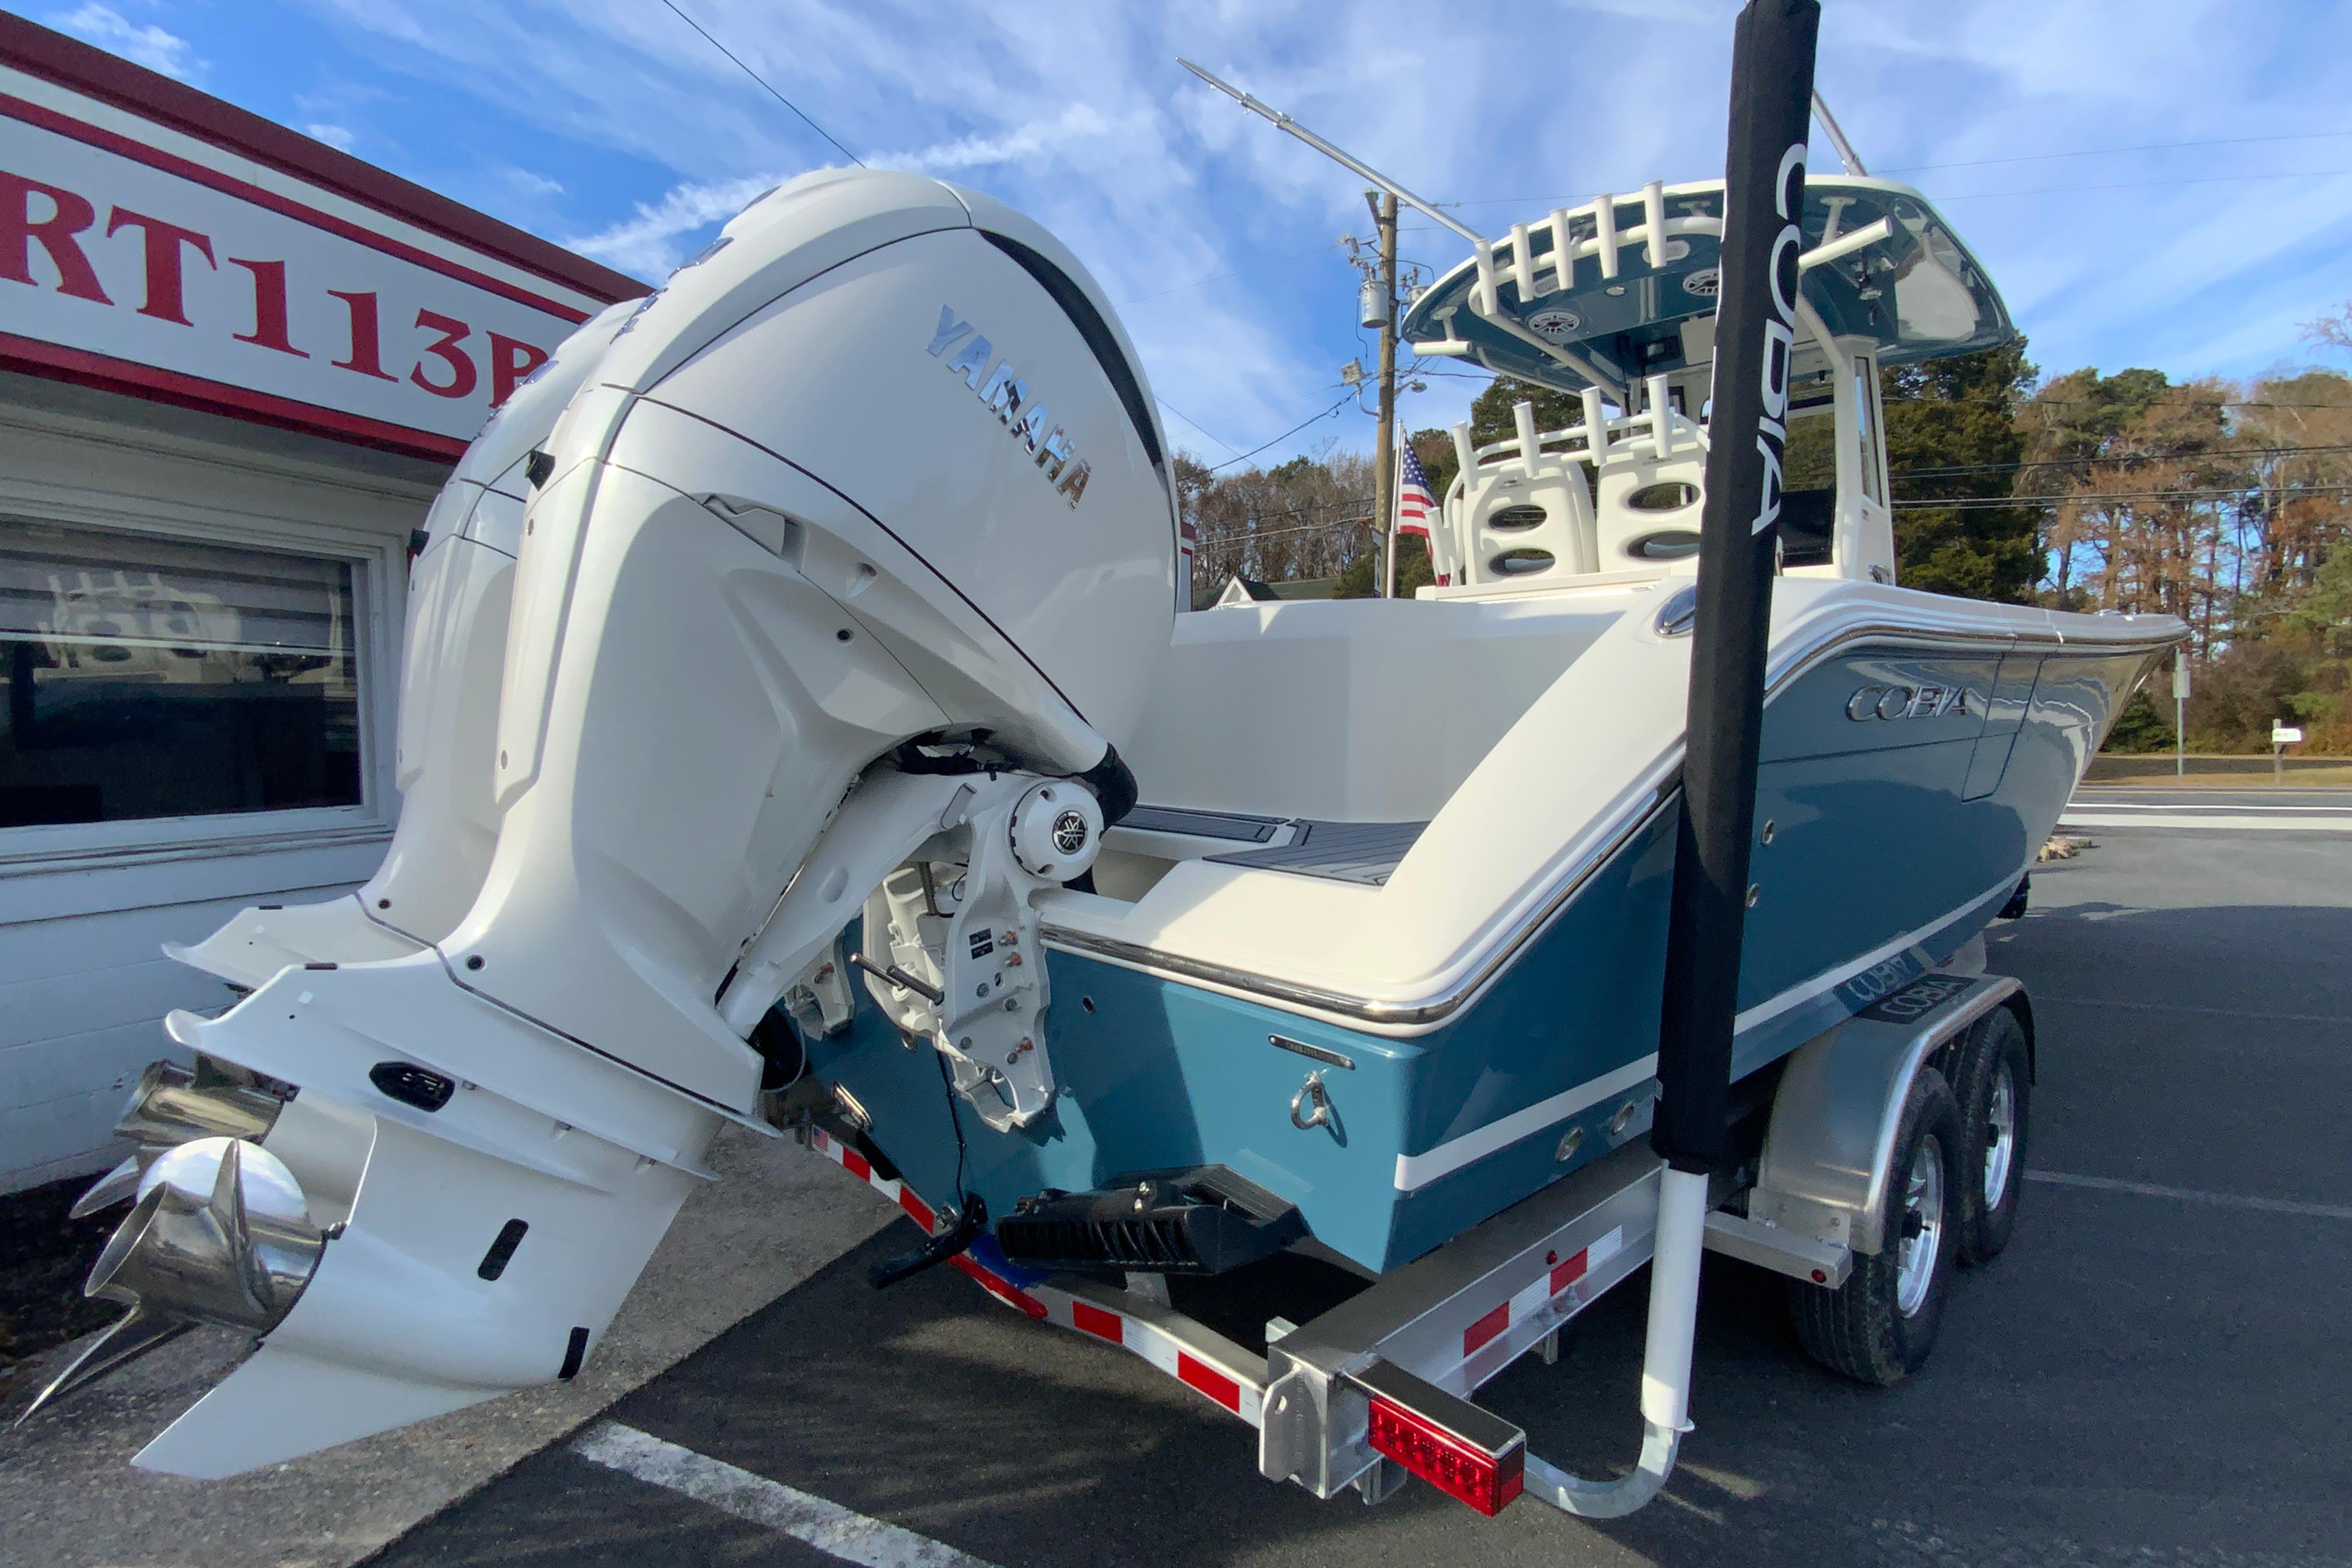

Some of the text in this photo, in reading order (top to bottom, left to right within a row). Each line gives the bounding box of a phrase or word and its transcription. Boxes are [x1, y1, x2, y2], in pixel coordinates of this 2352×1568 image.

[926, 304, 1092, 512] YAMAHA
[1845, 685, 1967, 722] COBIA
[1880, 981, 1965, 1016] COBIA
